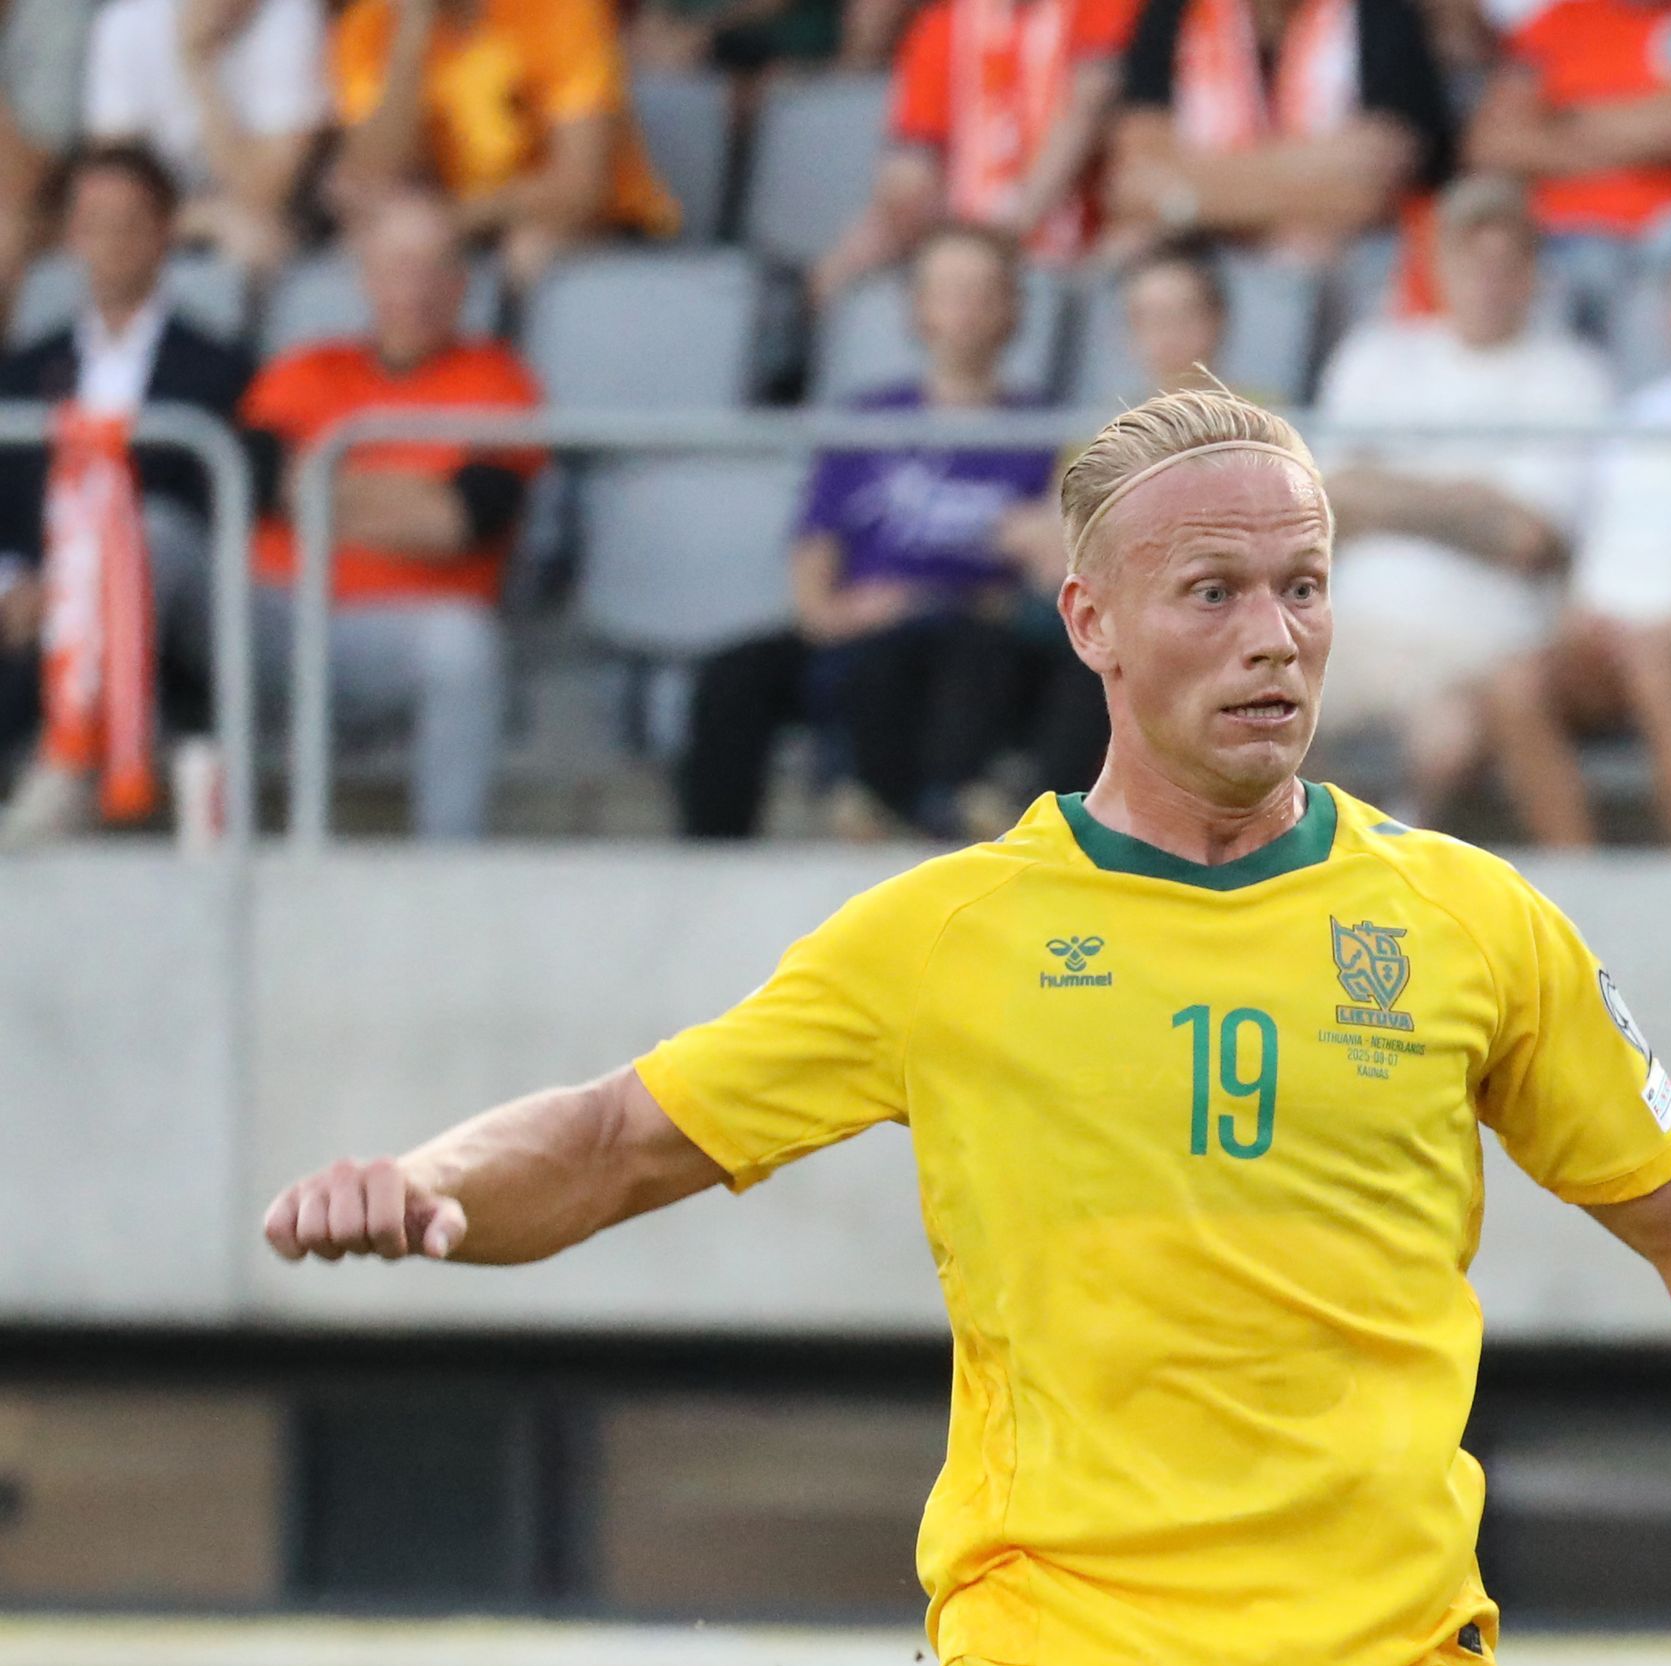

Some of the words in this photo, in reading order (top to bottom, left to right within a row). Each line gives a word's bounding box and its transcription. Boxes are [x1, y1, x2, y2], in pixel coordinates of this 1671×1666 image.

[1040, 971, 1112, 988] hummel
[1339, 1007, 1411, 1029] LIETUVA
[1318, 1029, 1363, 1046] LITHUANIA
[1370, 1034, 1426, 1056] NETHERLANDS
[1172, 1004, 1280, 1160] 19
[1356, 1064, 1390, 1080] KAUNAS
